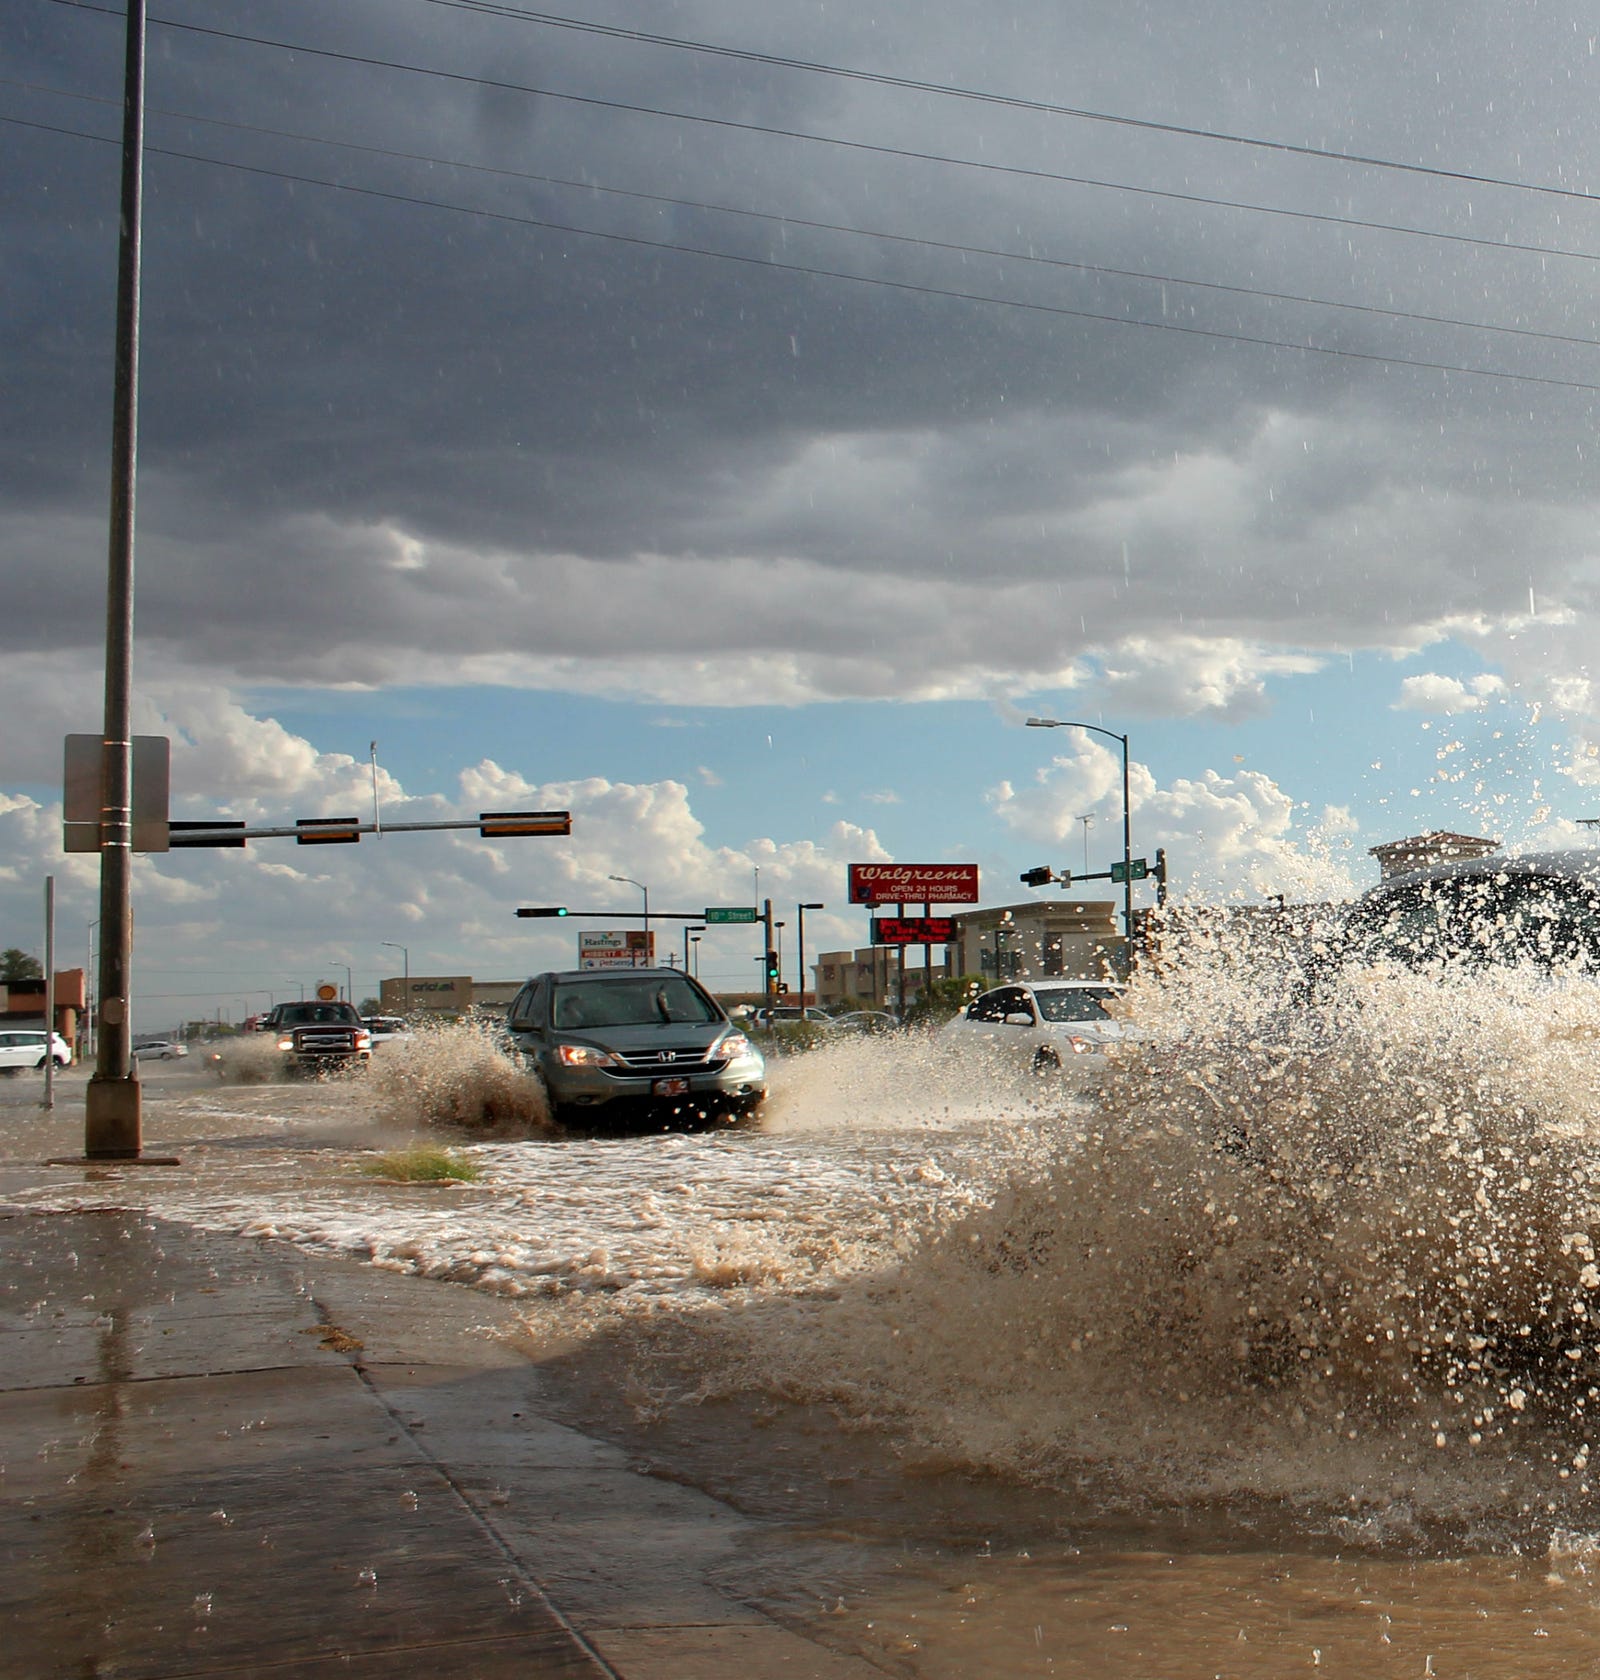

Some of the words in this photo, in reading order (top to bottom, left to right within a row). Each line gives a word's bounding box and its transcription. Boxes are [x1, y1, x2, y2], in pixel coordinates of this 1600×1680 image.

[857, 867, 973, 884] Walgreens
[727, 911, 752, 920] Street
[584, 938, 621, 947] Hastings
